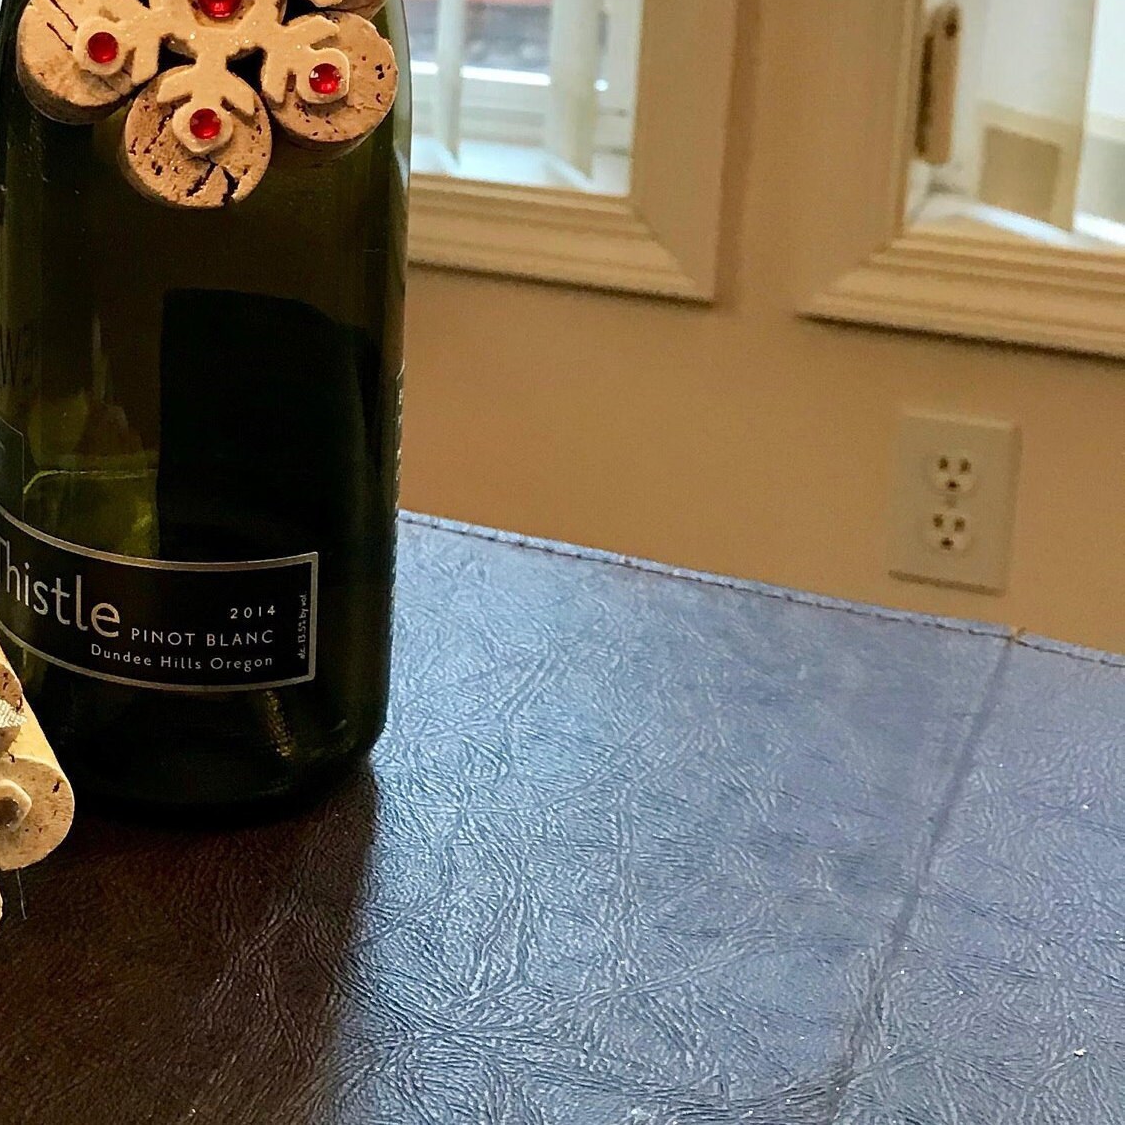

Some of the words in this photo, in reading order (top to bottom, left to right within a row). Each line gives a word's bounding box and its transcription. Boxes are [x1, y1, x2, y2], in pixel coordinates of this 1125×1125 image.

[230, 605, 276, 620] 2014
[298, 607, 309, 619] by
[131, 627, 196, 647] PINOT
[206, 629, 274, 647] BLANC
[90, 643, 153, 666] Dundee
[160, 656, 202, 670] Hills
[210, 657, 273, 673] Oregon
